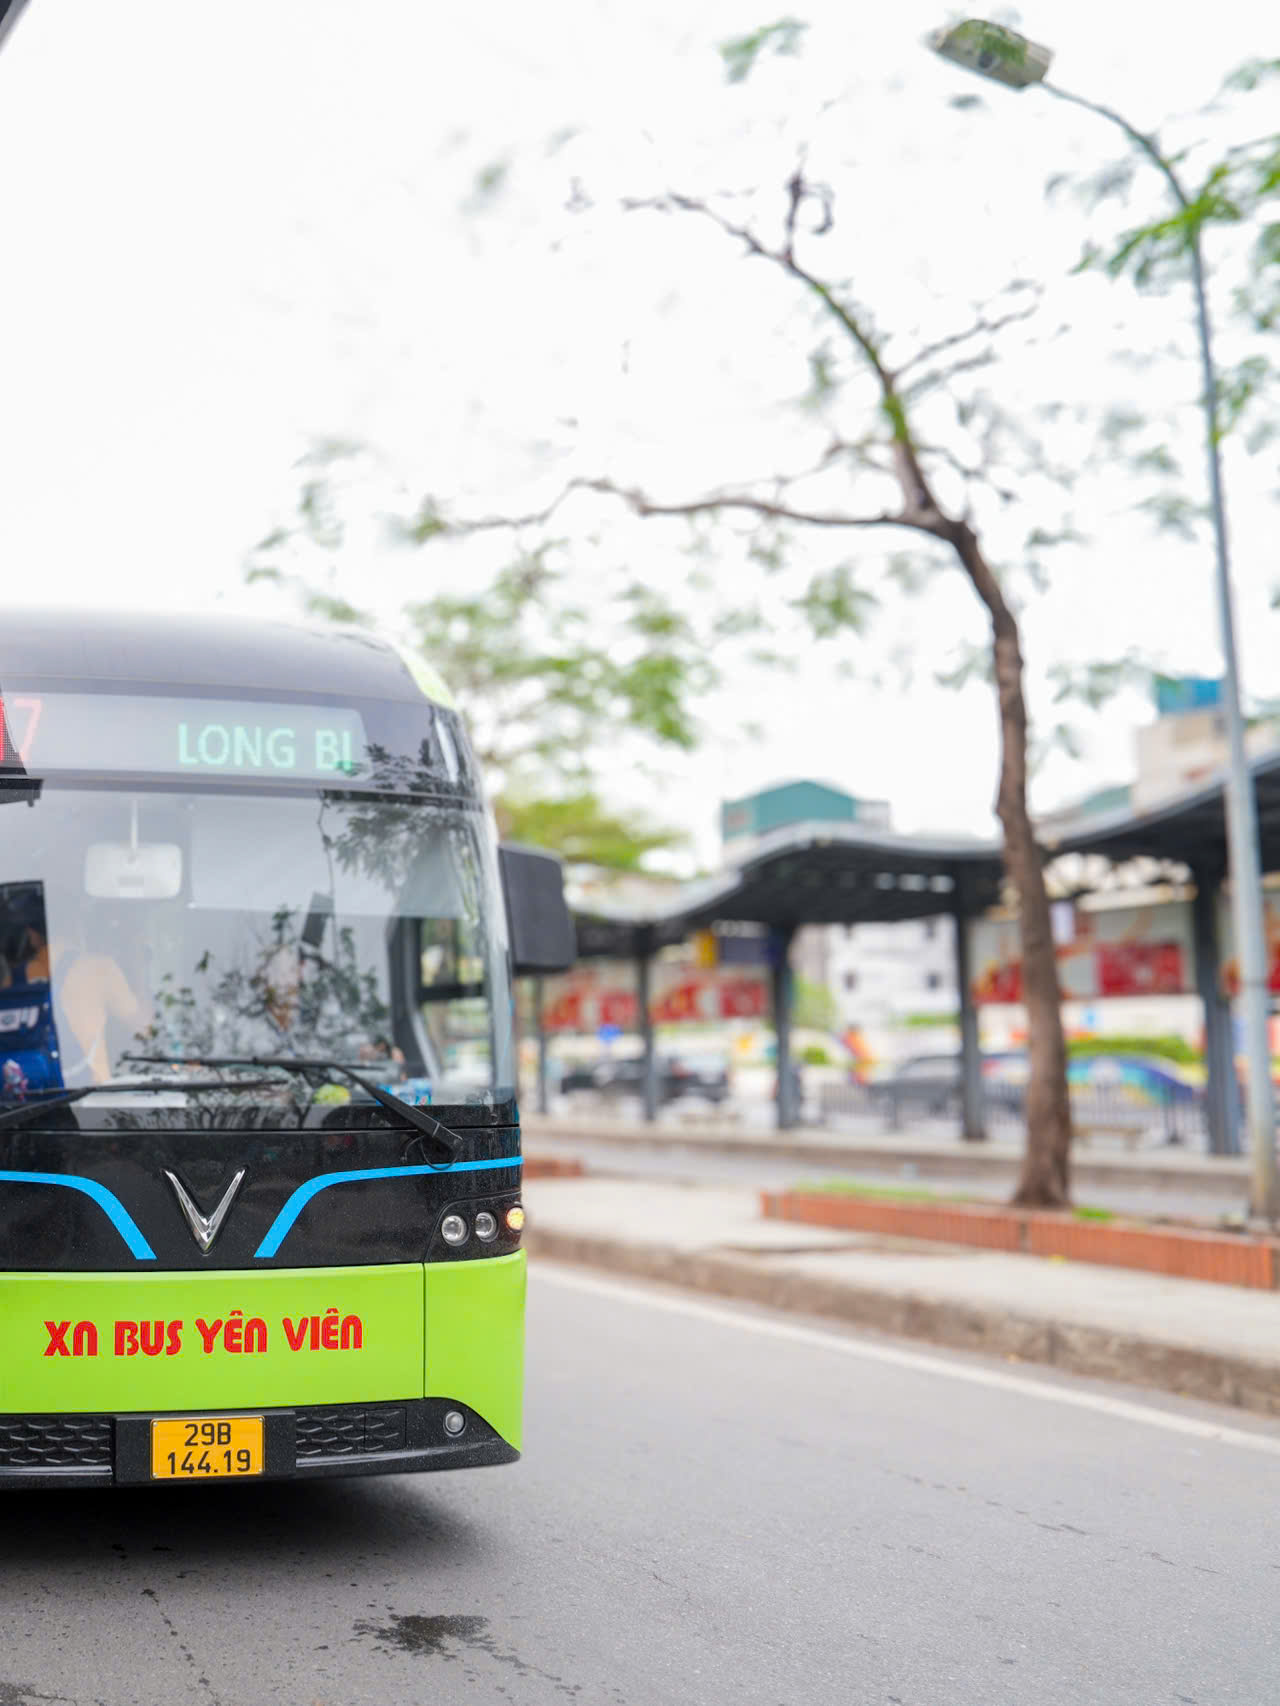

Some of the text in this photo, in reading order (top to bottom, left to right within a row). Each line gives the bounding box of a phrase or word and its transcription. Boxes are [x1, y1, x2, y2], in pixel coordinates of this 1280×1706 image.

[177, 723, 296, 769] LONG
[43, 1307, 363, 1357] XN BUS YÊN VIÊN
[184, 1422, 232, 1447] 29B
[167, 1449, 251, 1475] 144.19
